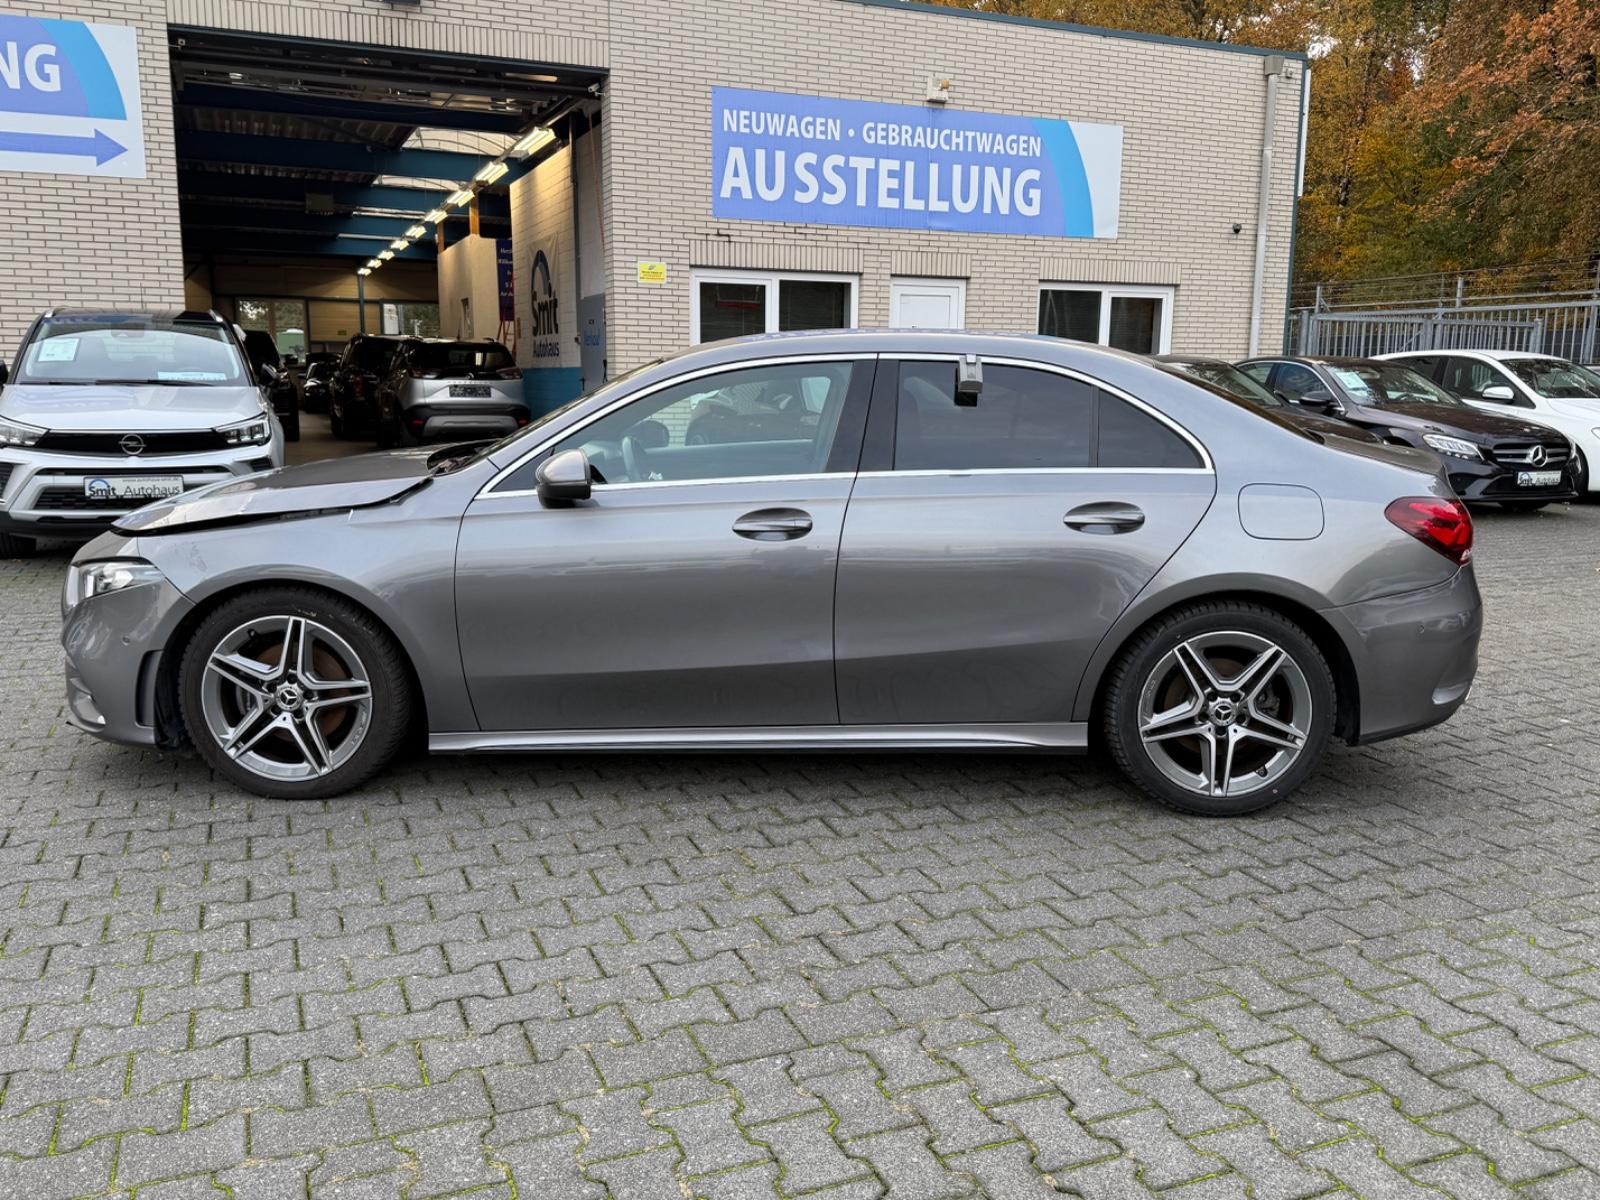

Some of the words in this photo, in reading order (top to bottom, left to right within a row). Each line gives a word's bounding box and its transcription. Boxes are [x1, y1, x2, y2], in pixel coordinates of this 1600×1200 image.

[723, 108, 840, 141] NEUWAGEN
[862, 121, 1042, 157] GEBRAUCHTWAGEN
[719, 146, 1042, 217] AUSSTELLUNG
[531, 283, 559, 336] Smit
[533, 338, 560, 359] Autohaus
[89, 485, 116, 496] Smit
[124, 484, 181, 496] Autohaus
